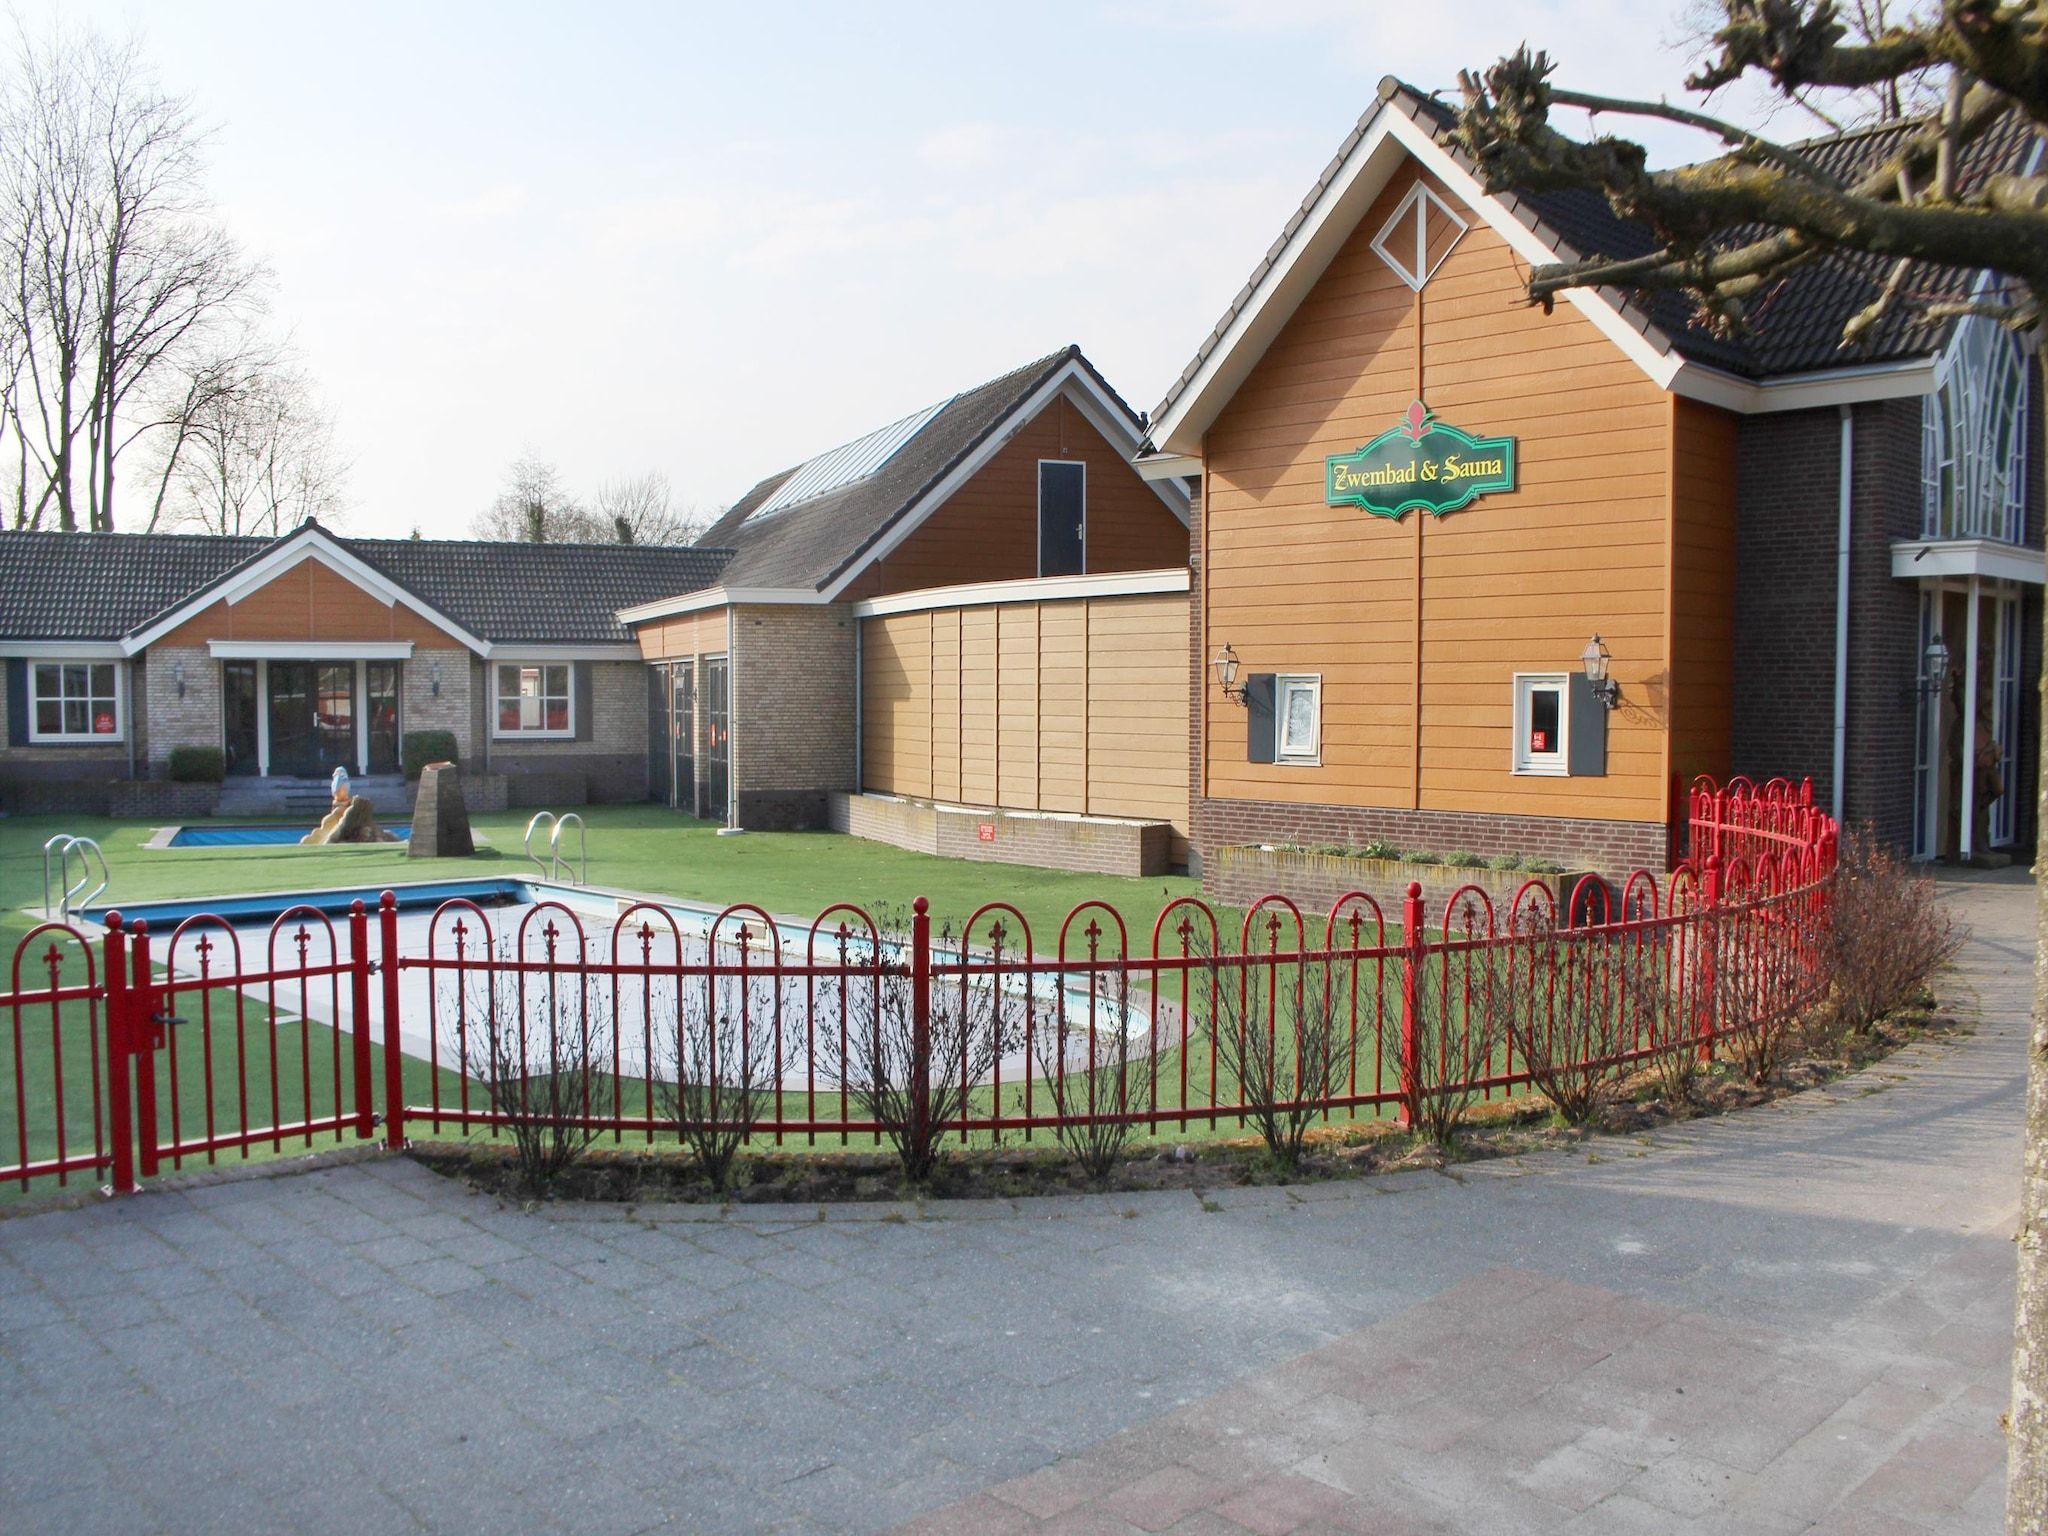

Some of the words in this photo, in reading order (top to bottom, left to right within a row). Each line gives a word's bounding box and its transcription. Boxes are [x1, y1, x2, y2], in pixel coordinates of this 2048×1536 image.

[1333, 460, 1416, 491] Zwembad
[1420, 460, 1439, 481] &
[1441, 453, 1502, 485] Sauna
